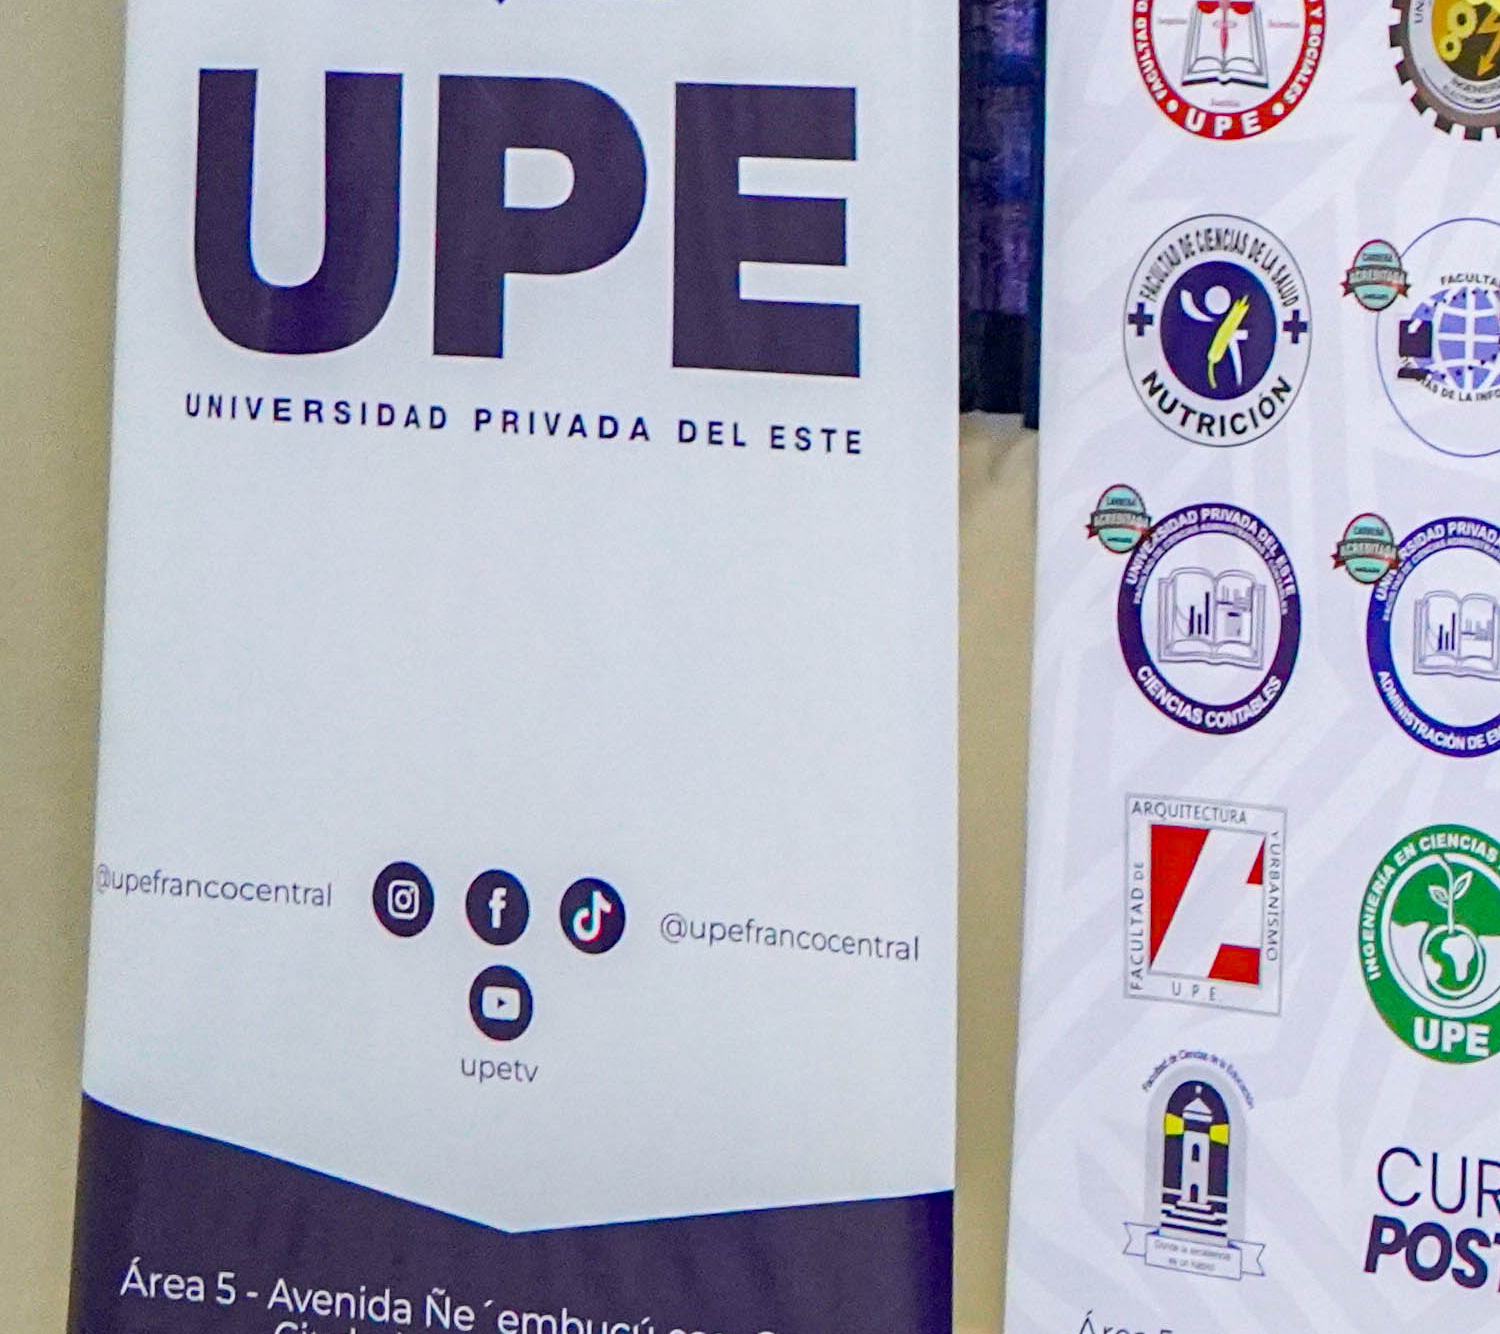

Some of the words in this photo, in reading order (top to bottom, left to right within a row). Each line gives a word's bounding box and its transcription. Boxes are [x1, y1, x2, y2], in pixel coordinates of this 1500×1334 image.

[1184, 108, 1262, 137] UPE
[194, 67, 861, 378] UPE
[1271, 264, 1299, 308] SALUD
[185, 393, 449, 432] UNIVERSIDAD
[473, 408, 651, 443] PRIVADA
[676, 419, 747, 448] DEL
[769, 425, 862, 455] ESTE
[1141, 370, 1292, 437] NUTRICIÓN
[1201, 506, 1259, 537] PRIVADA
[1258, 526, 1279, 557] DEL
[1277, 554, 1297, 597] ESTE
[1136, 665, 1204, 725] CIENCIAS
[1204, 675, 1282, 729] CONTABLES
[1466, 734, 1487, 750] DE
[1131, 800, 1248, 825] ARQUITECTURA
[1134, 861, 1145, 881] DE
[1394, 845, 1418, 867] EN
[1418, 833, 1499, 863] CIENCIAS
[1266, 842, 1282, 962] URBANISMO
[659, 912, 921, 963] @upefrancocentral
[1130, 887, 1145, 991] FACULTAD
[1172, 982, 1217, 1002] UPE
[1413, 1016, 1491, 1058] UPE
[459, 1055, 540, 1086] upetv
[120, 1257, 206, 1304] Área
[214, 1272, 237, 1305] 5
[267, 1278, 412, 1326] Avenida
